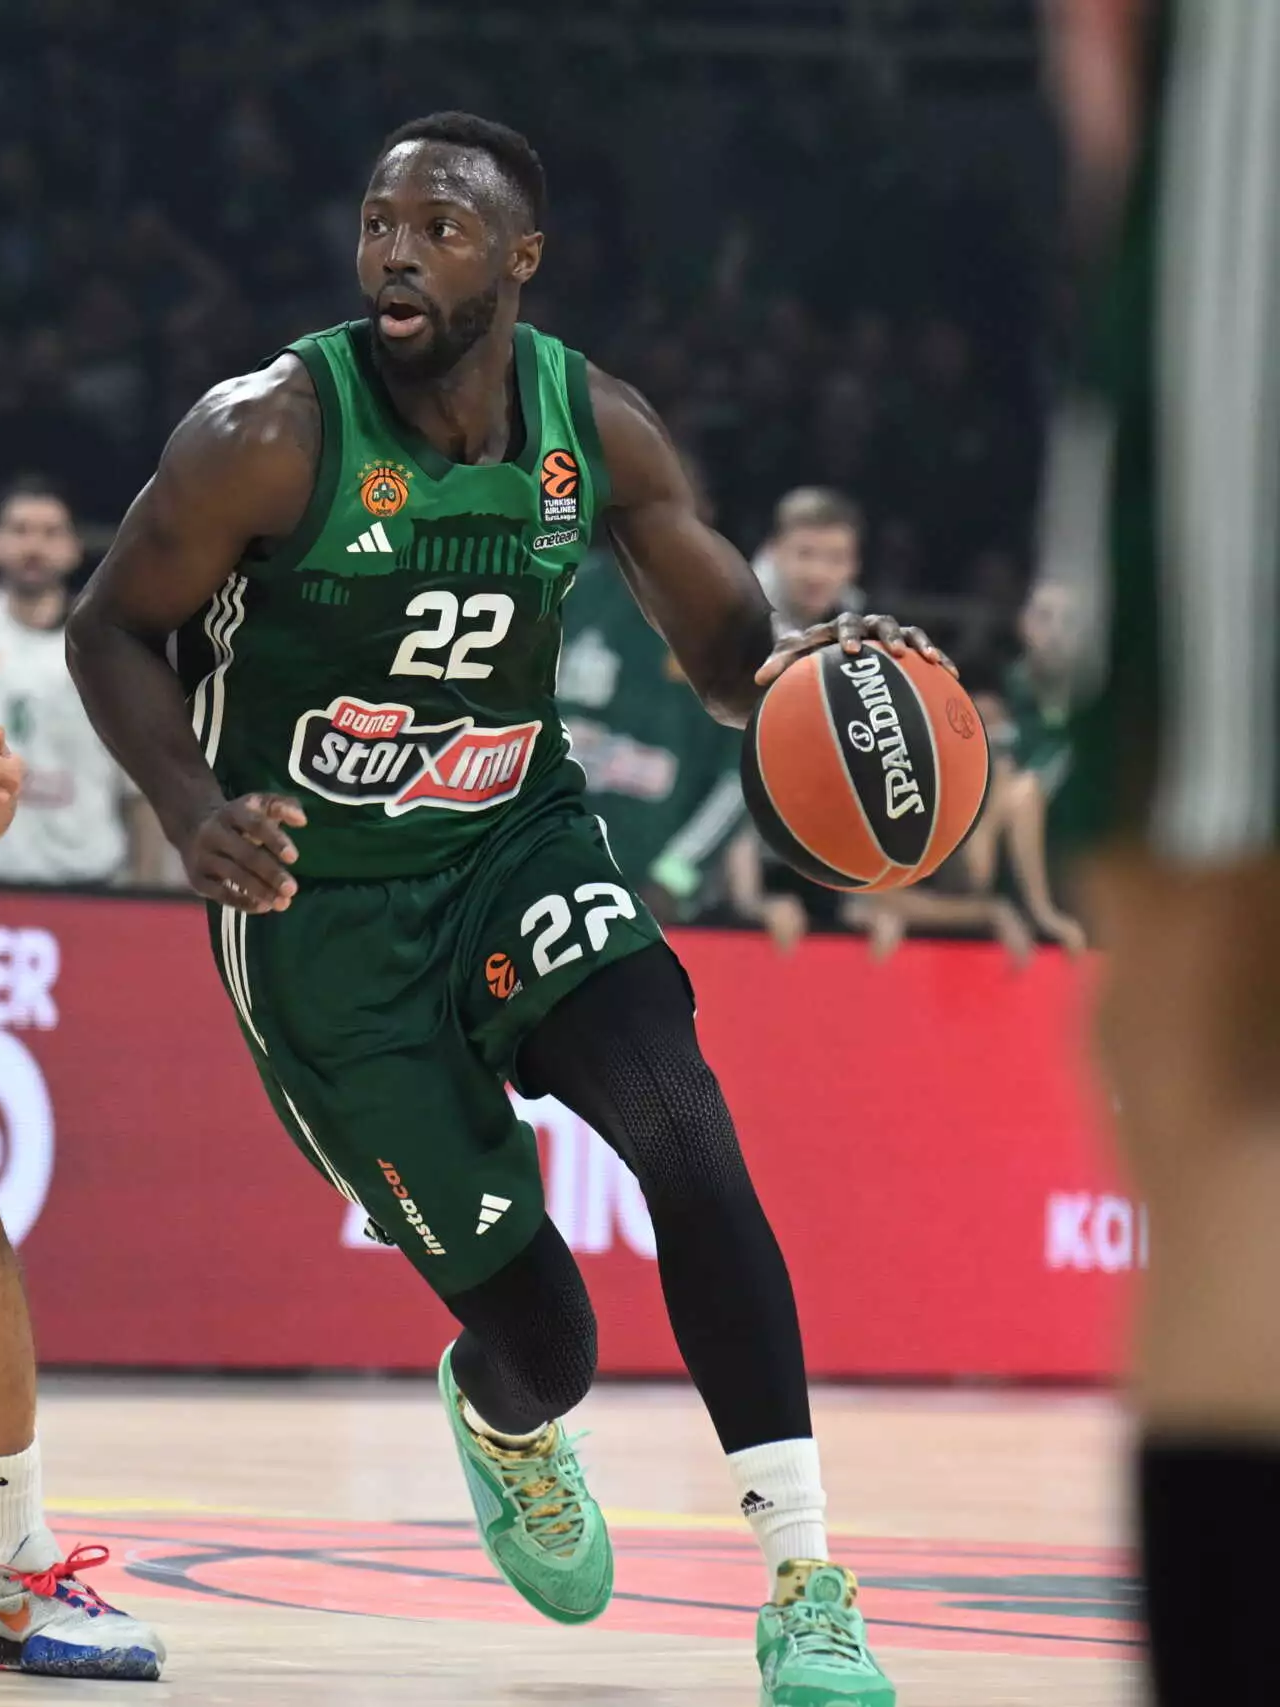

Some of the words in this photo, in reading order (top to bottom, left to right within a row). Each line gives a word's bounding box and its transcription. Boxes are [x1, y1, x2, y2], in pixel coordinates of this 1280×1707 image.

[543, 498, 577, 508] TURKISH
[544, 505, 577, 515] AIRLINES
[534, 528, 579, 549] oneteam
[388, 590, 515, 680] 22
[338, 707, 399, 734] pame
[839, 654, 926, 821] SPALDING
[520, 882, 637, 977] 22
[376, 1158, 447, 1255] instacar
